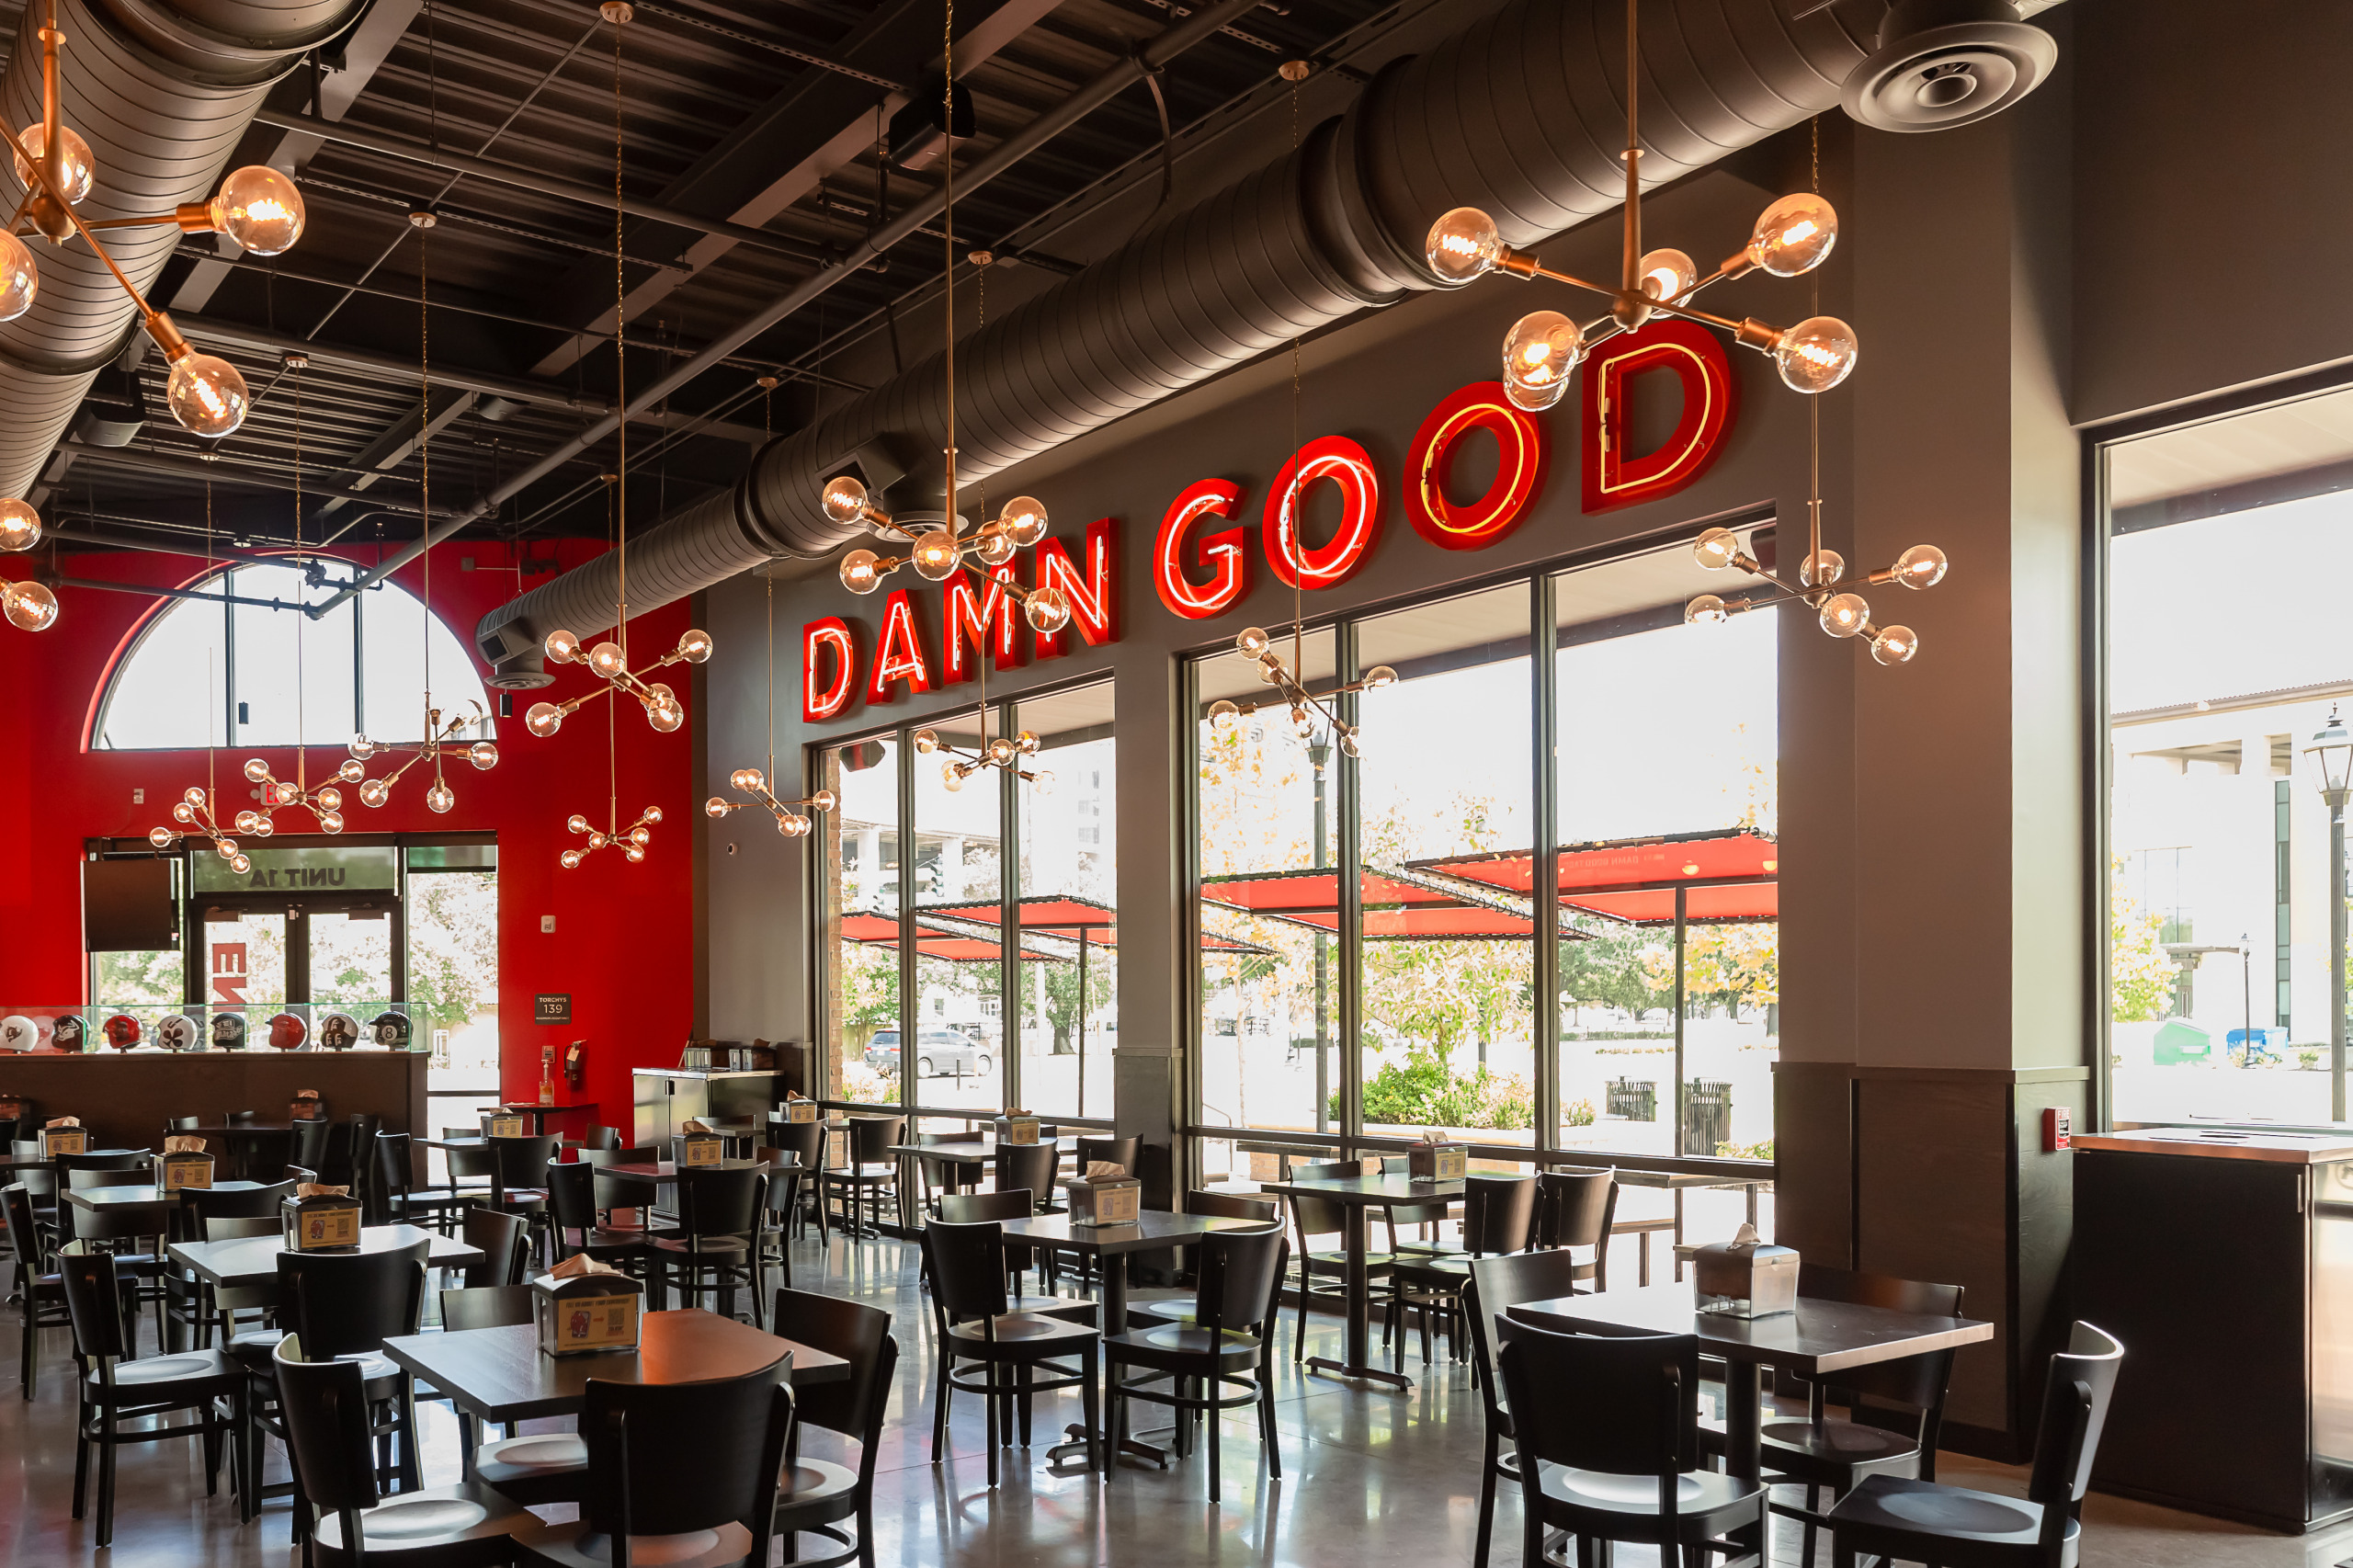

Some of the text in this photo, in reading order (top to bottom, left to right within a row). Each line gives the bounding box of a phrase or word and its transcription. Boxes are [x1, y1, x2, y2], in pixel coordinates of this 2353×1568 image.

[803, 320, 1732, 723] DAMN GOOD
[543, 1004, 563, 1014] 139
[386, 1028, 393, 1039] 8
